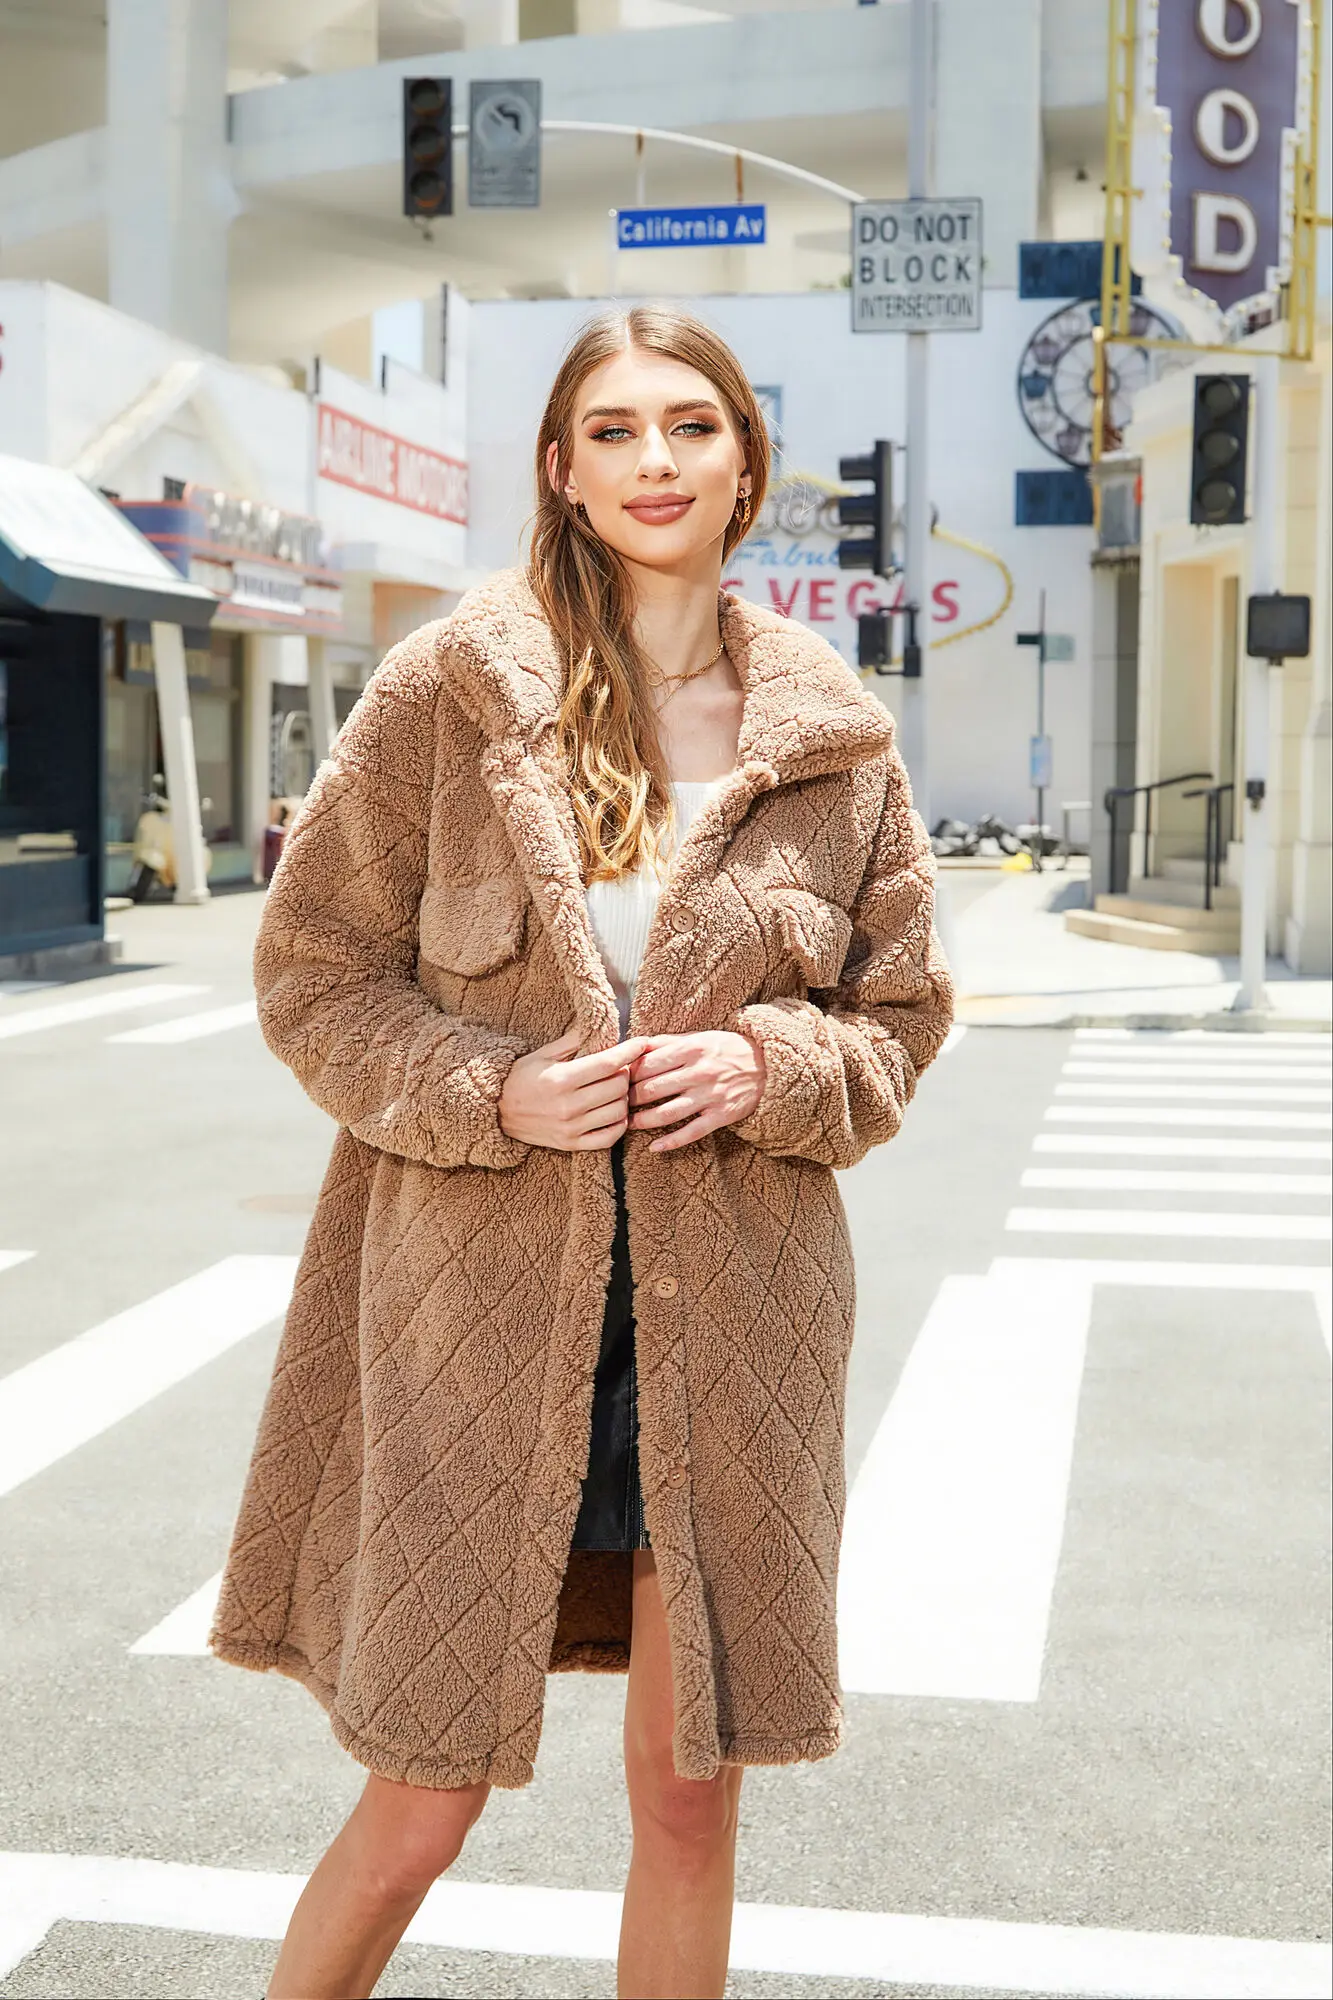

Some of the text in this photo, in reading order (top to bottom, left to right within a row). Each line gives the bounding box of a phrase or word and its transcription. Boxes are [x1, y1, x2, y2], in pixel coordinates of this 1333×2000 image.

[618, 213, 764, 243] California Av
[859, 213, 973, 244] DO NOT
[859, 255, 972, 284] BLOCK
[858, 295, 974, 320] INTERSECTION
